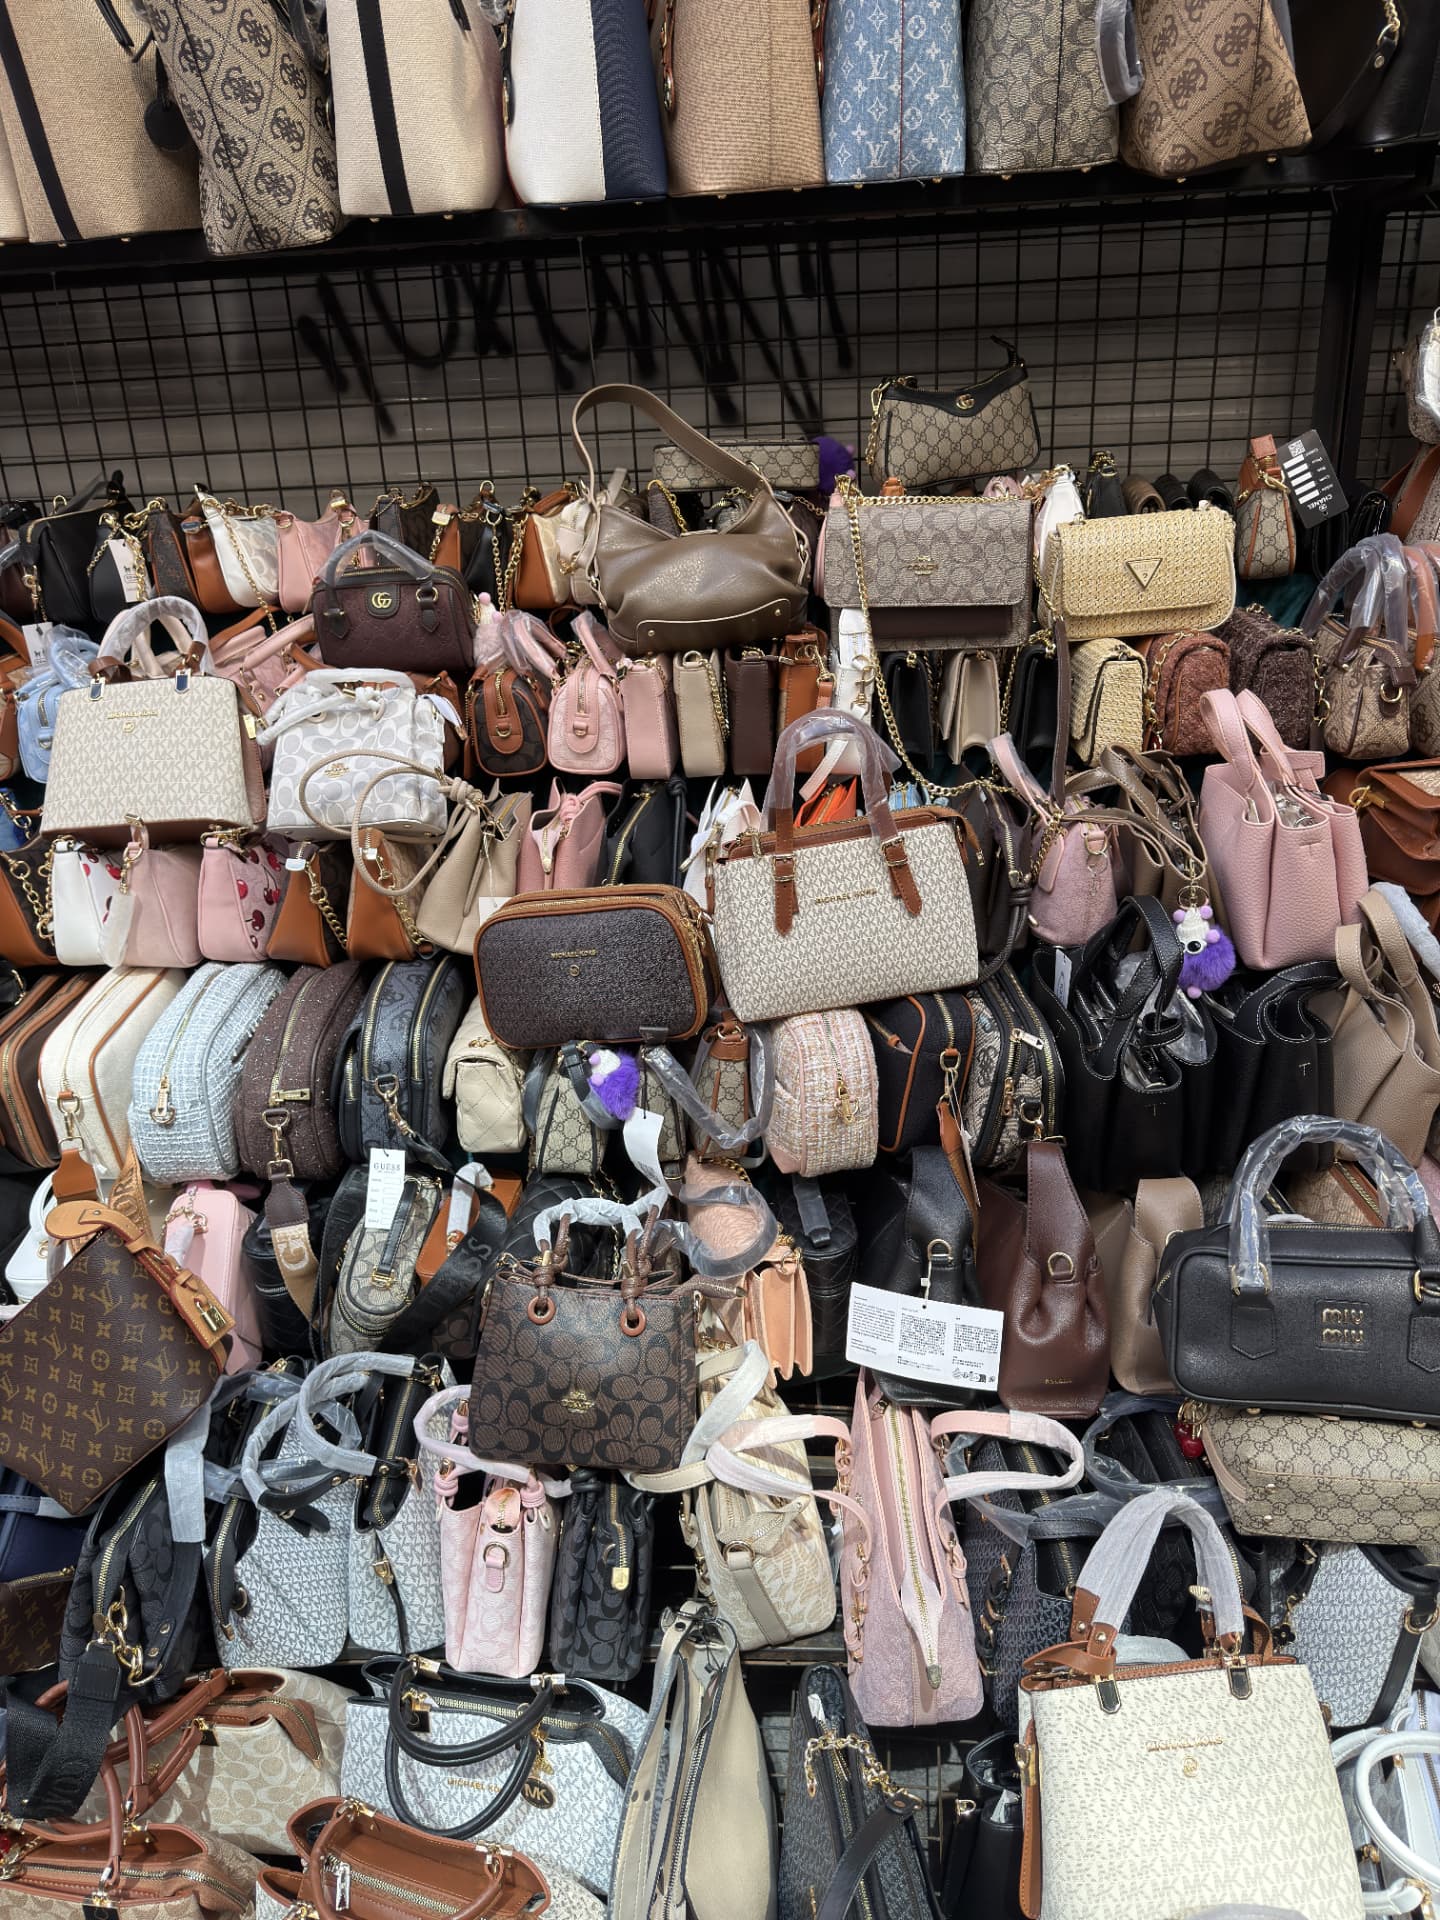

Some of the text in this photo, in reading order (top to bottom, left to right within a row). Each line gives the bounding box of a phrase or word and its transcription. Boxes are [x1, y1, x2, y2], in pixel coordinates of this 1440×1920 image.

[1307, 494, 1333, 510] CHANEL
[373, 1162, 401, 1171] GUESS
[447, 1777, 485, 1791] MICHAEL
[523, 1782, 550, 1805] MK
